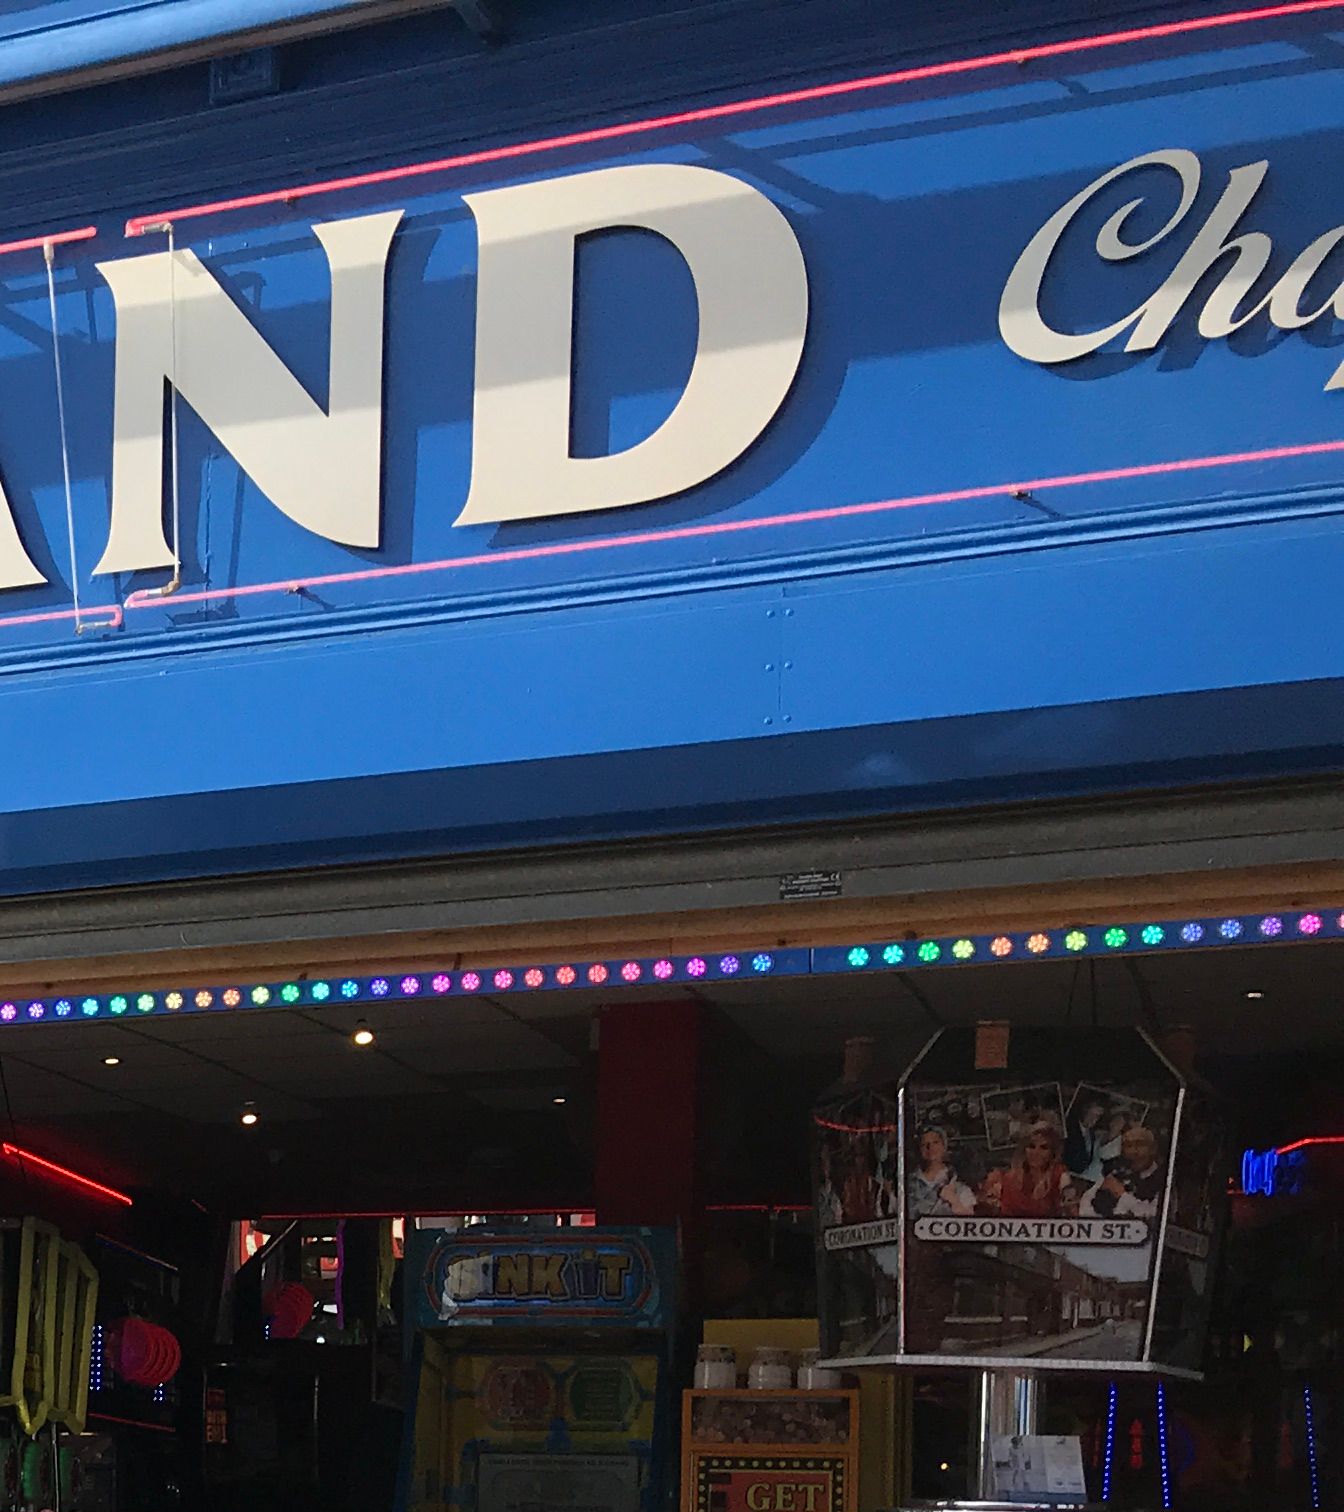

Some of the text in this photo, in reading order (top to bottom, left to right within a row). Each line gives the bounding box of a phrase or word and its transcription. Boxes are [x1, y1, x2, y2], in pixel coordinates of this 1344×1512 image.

[999, 148, 1344, 391] Cha
[929, 1222, 1132, 1240] CORONATION ST.
[745, 1481, 825, 1512] GET
